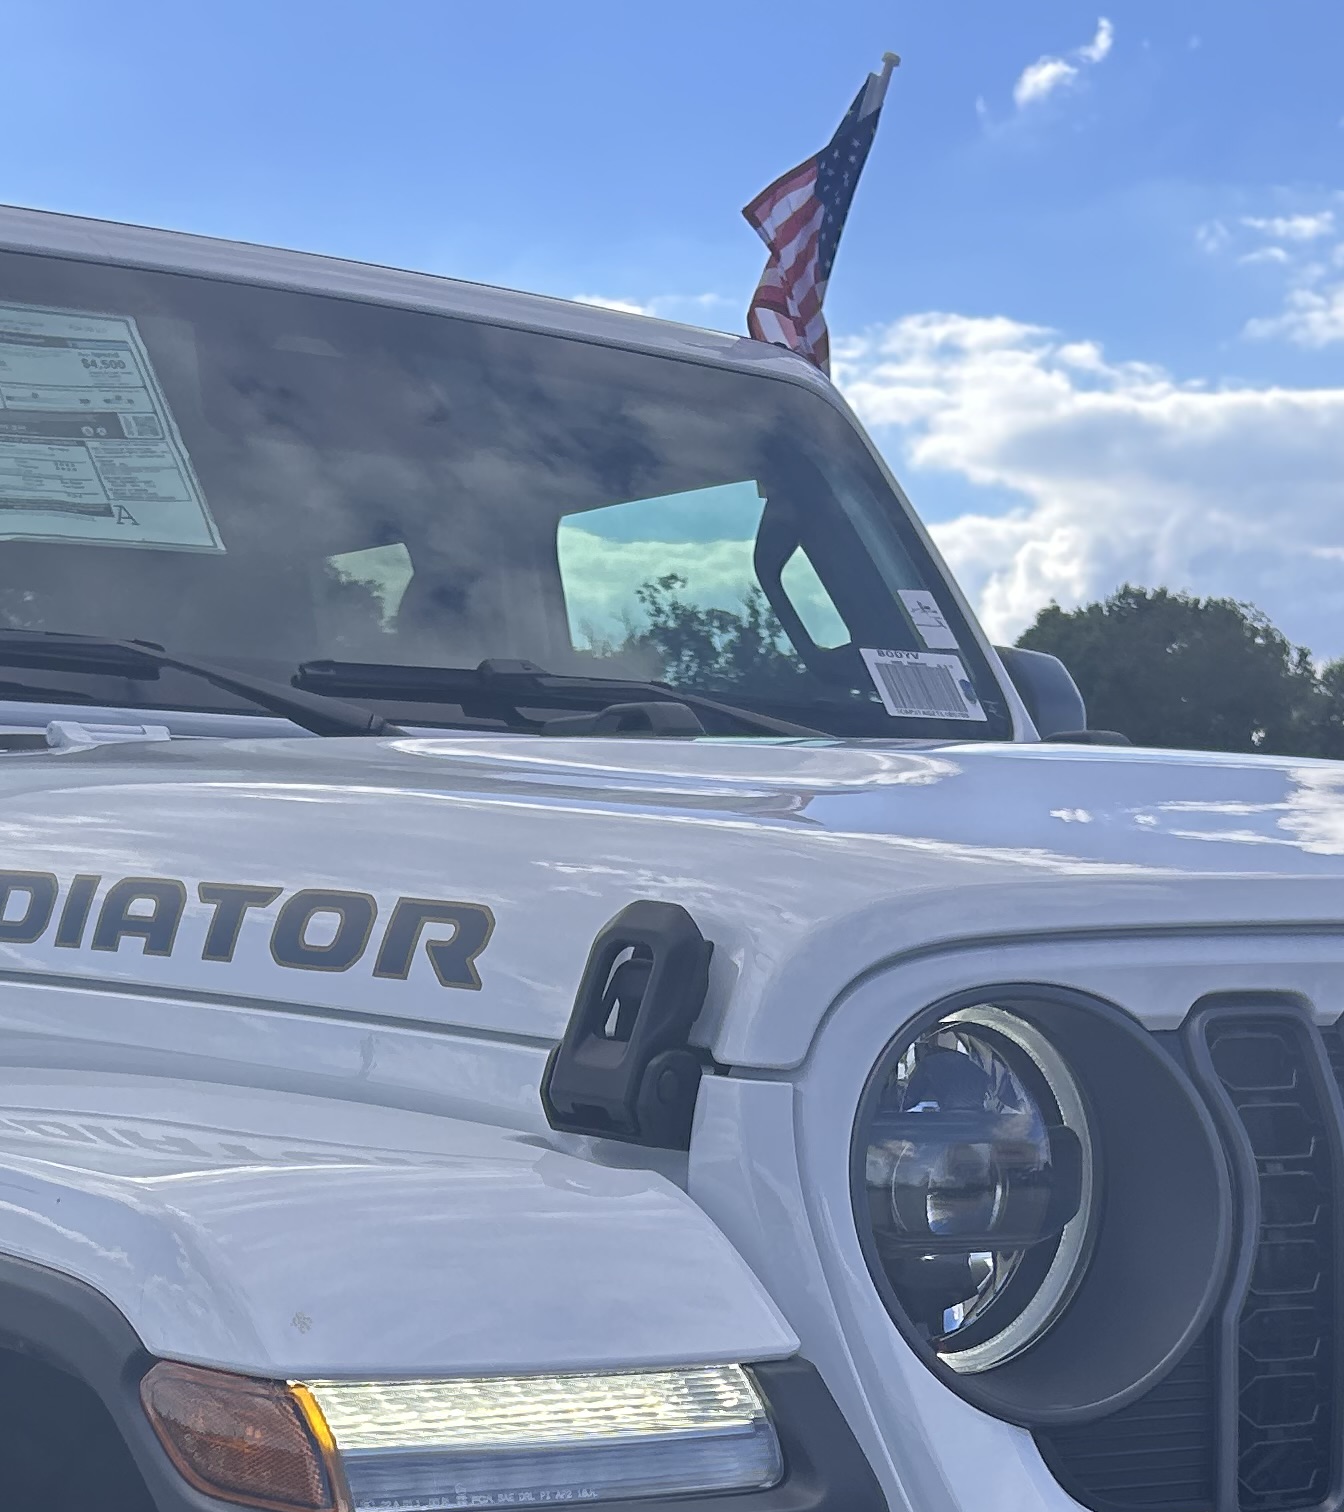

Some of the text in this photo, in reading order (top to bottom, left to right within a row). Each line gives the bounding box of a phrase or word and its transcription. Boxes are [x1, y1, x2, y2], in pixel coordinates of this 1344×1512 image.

[81, 358, 126, 370] $4,500
[113, 505, 140, 526] A
[518, 1490, 535, 1502] DRL
